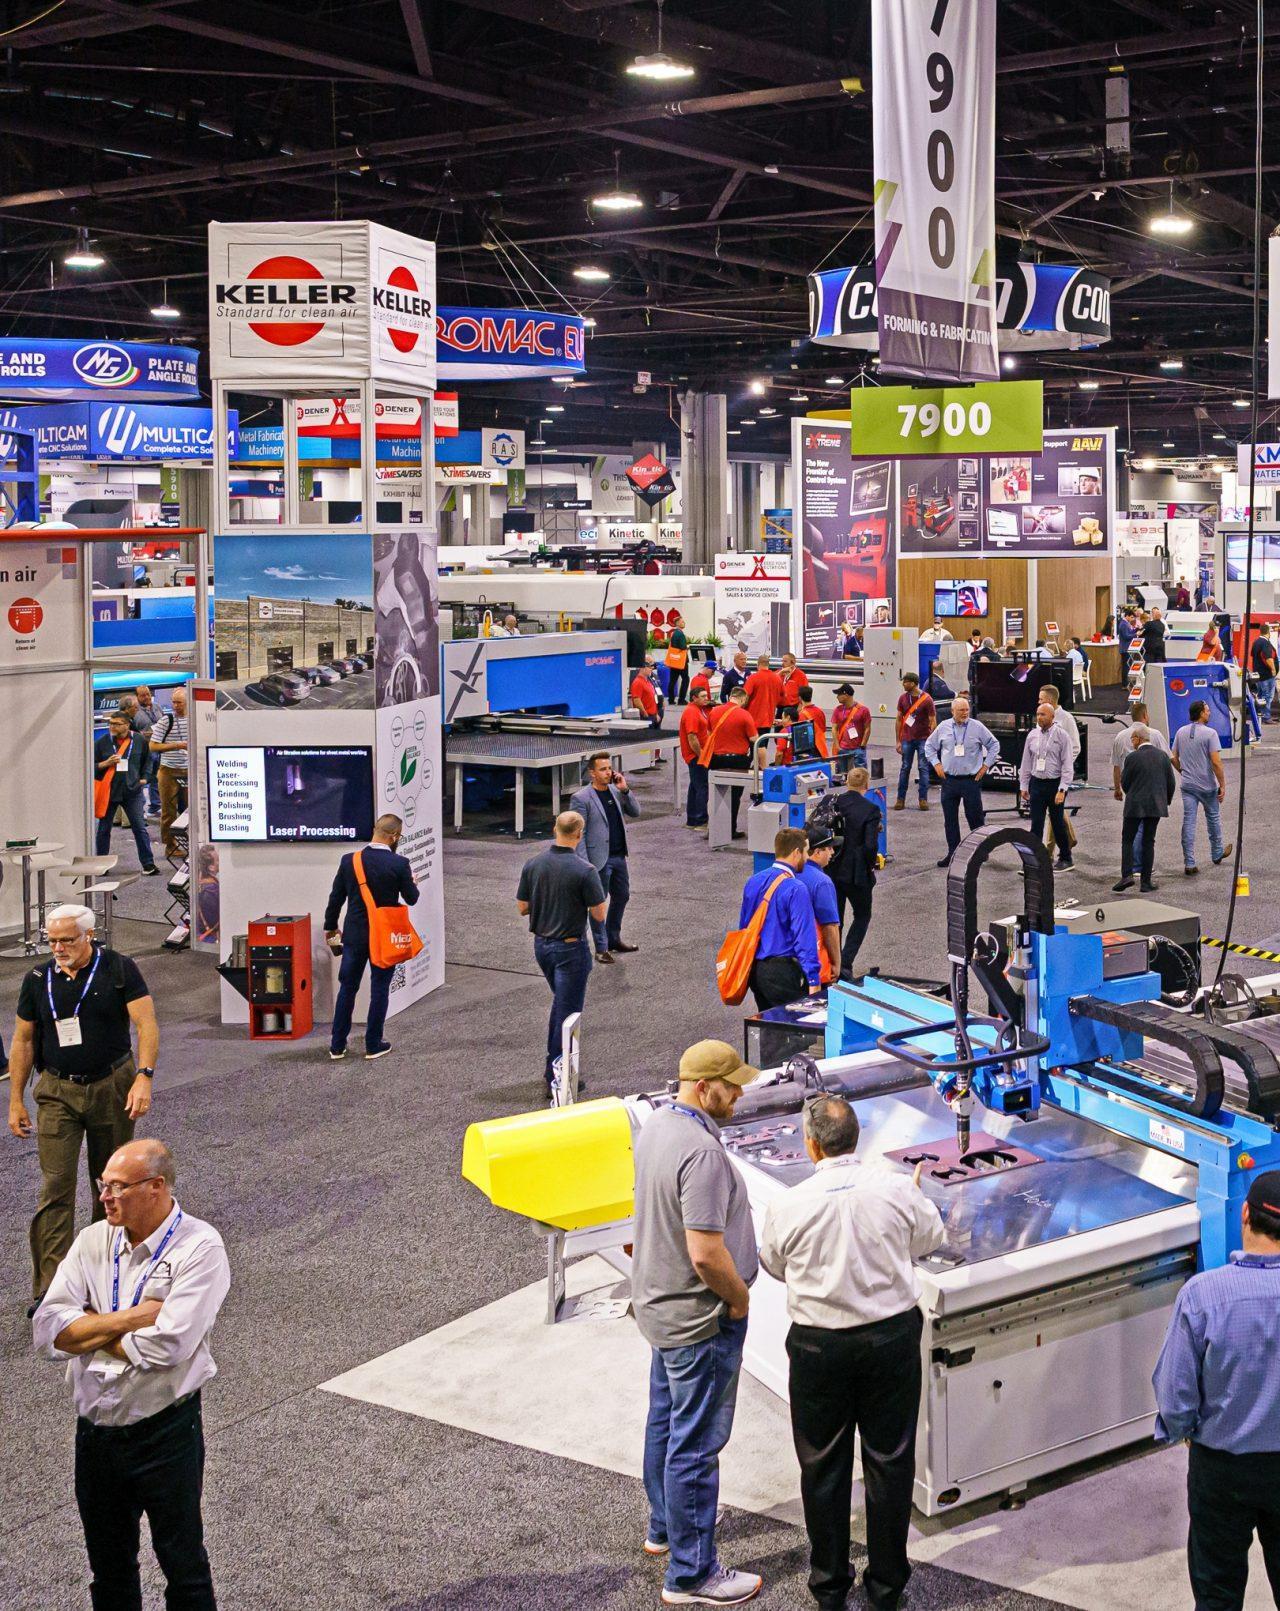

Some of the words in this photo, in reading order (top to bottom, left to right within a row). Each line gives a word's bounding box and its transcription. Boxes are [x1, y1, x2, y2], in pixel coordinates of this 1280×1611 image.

[215, 284, 357, 304] KELLER
[373, 286, 432, 319] KELLER
[216, 306, 274, 319] Standard
[278, 306, 297, 318] for
[301, 306, 338, 319] clean
[340, 307, 359, 318] air
[884, 314, 926, 337] FORMING
[930, 320, 938, 338] &
[437, 316, 556, 356] ROMAC
[10, 353, 46, 365] AND
[82, 349, 122, 377] MG
[2, 365, 46, 377] ROLLS
[148, 358, 184, 372] PLATE
[186, 362, 197, 374] AND
[148, 371, 181, 383] ANGLE
[385, 405, 414, 414] DENER
[898, 402, 992, 438] 7900
[32, 424, 88, 443] ULTICAM
[238, 430, 256, 442] Metal
[258, 429, 284, 442] Fabricat
[144, 445, 180, 454] Complete
[182, 445, 199, 454] CNC
[1044, 440, 1068, 449] Support
[248, 444, 284, 458] Machinery
[391, 445, 422, 458] Machin
[380, 467, 422, 480] TIMESAVERS
[449, 466, 492, 479] TIMESAVERS
[649, 484, 673, 492] Kintic
[609, 529, 645, 538] Kinetic
[660, 528, 682, 538] Kine
[15, 566, 37, 582] air
[216, 760, 248, 769] Welding
[217, 771, 240, 779] Laser-
[217, 780, 259, 788] Processing
[217, 790, 250, 799] Grinding
[218, 801, 253, 810] Polishing
[218, 812, 252, 821] Brushing
[219, 823, 250, 832] Blasting
[269, 825, 298, 836] Laser
[299, 825, 356, 838] Processing
